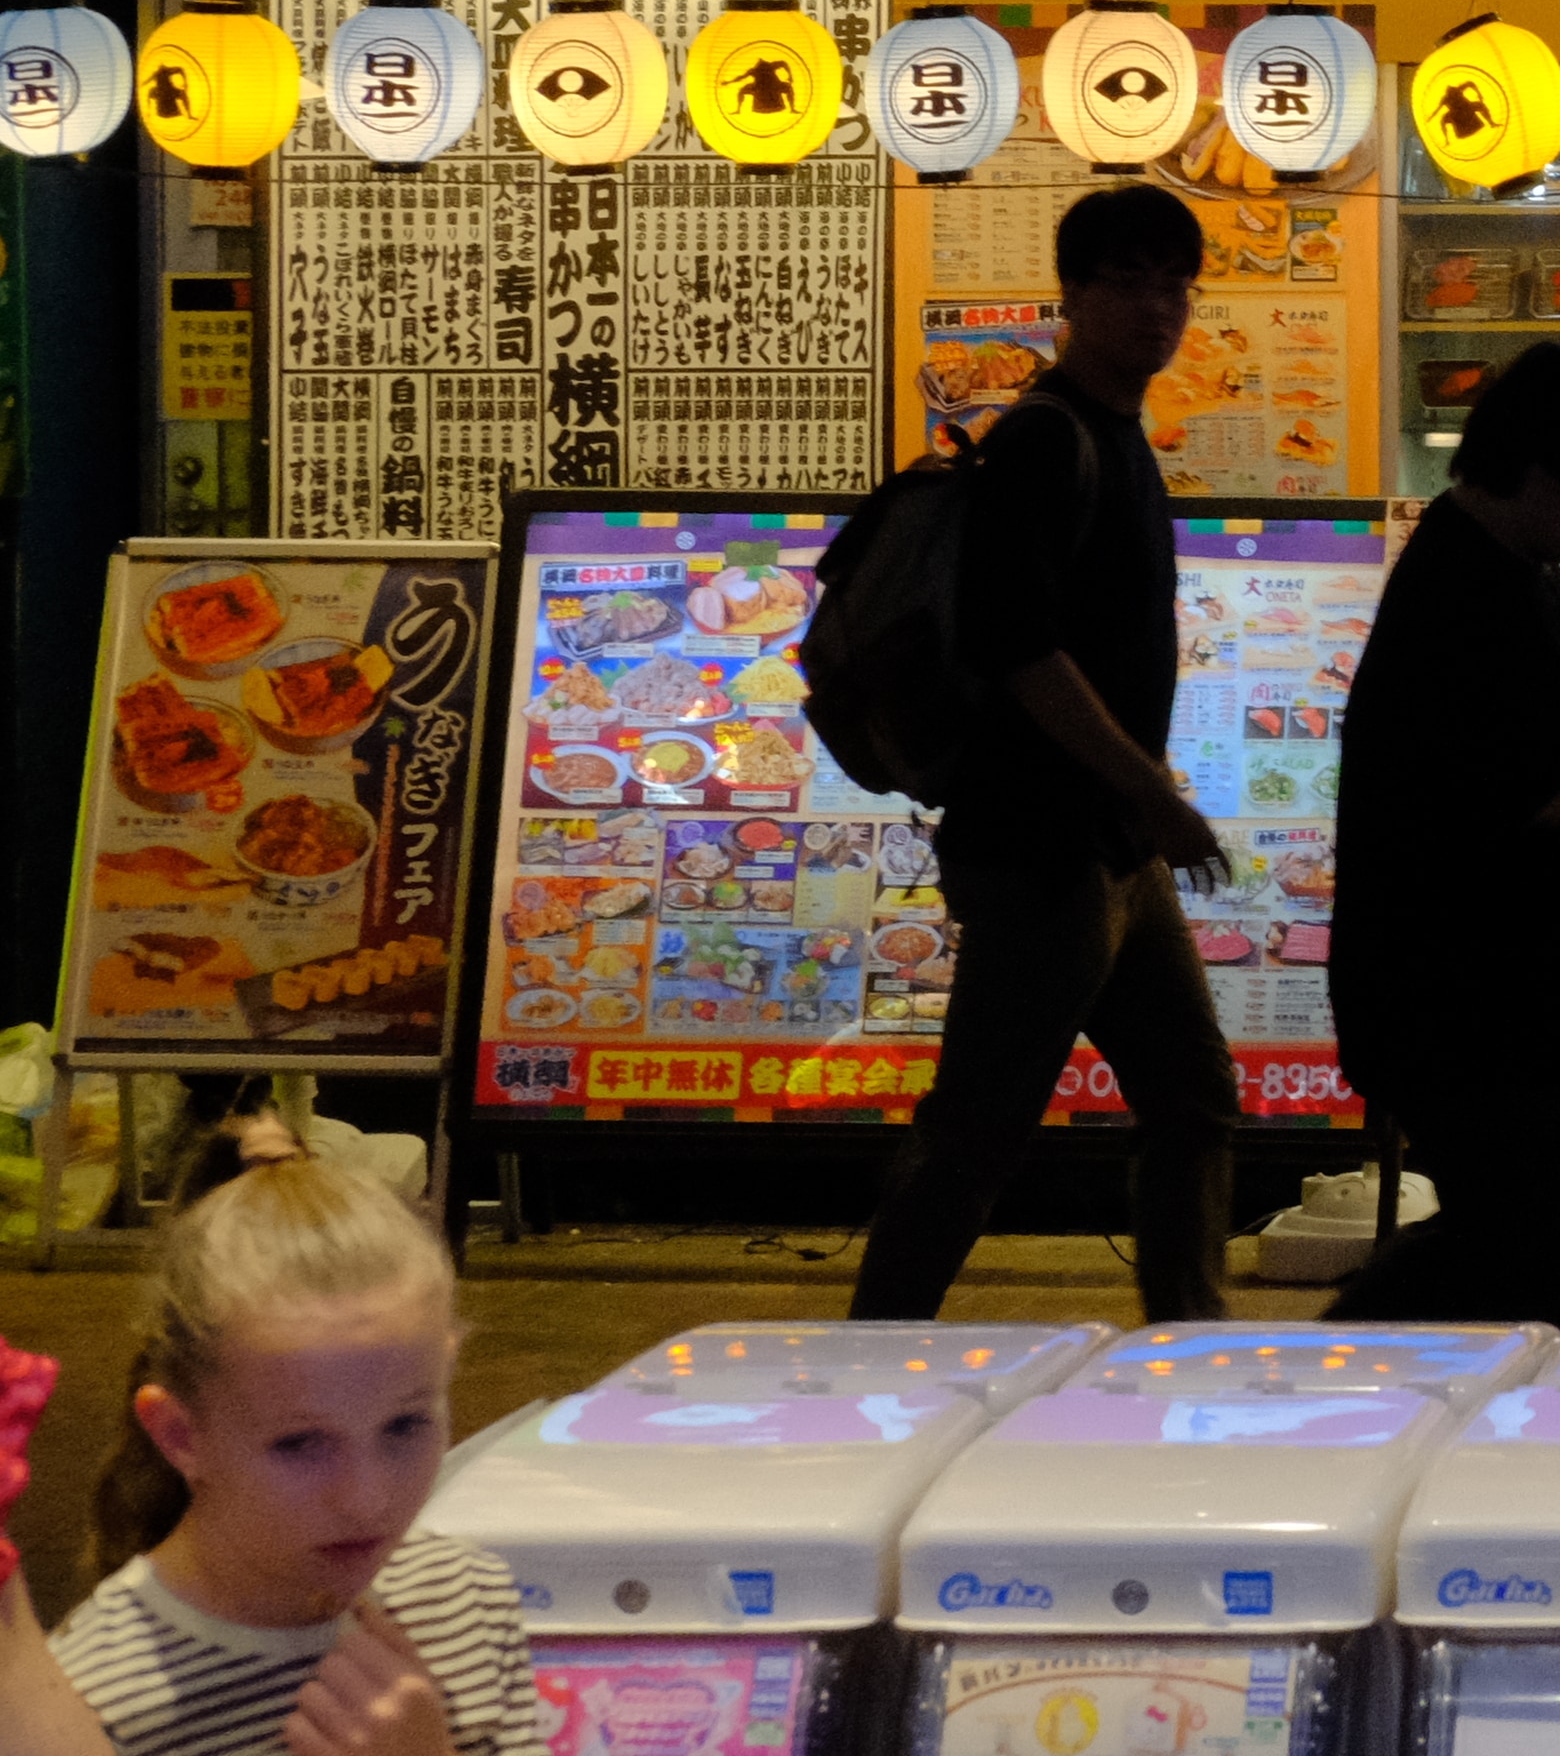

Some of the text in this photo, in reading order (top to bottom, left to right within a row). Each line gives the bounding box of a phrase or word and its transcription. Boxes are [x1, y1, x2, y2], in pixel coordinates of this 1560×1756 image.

[358, 52, 421, 119] 日本一
[909, 61, 969, 126] 日本一
[1254, 60, 1313, 127] 日本一
[421, 244, 439, 366] サーモン
[443, 244, 461, 366] はまち
[494, 265, 536, 364] 寿司
[548, 179, 582, 347] 串かつ
[586, 178, 619, 347] 日本一の
[632, 254, 649, 365] しいたけ
[653, 254, 670, 365] ししとう
[673, 254, 692, 365] じゃがいも
[714, 254, 732, 365] なす
[734, 254, 752, 365] 玉ねぎ
[755, 254, 773, 365] にんにく
[816, 254, 834, 365] うなぎ
[835, 254, 851, 365] ほたて
[549, 352, 620, 487] 横綱
[385, 575, 477, 925] うなぎフェア
[596, 1056, 737, 1094] 年中無休
